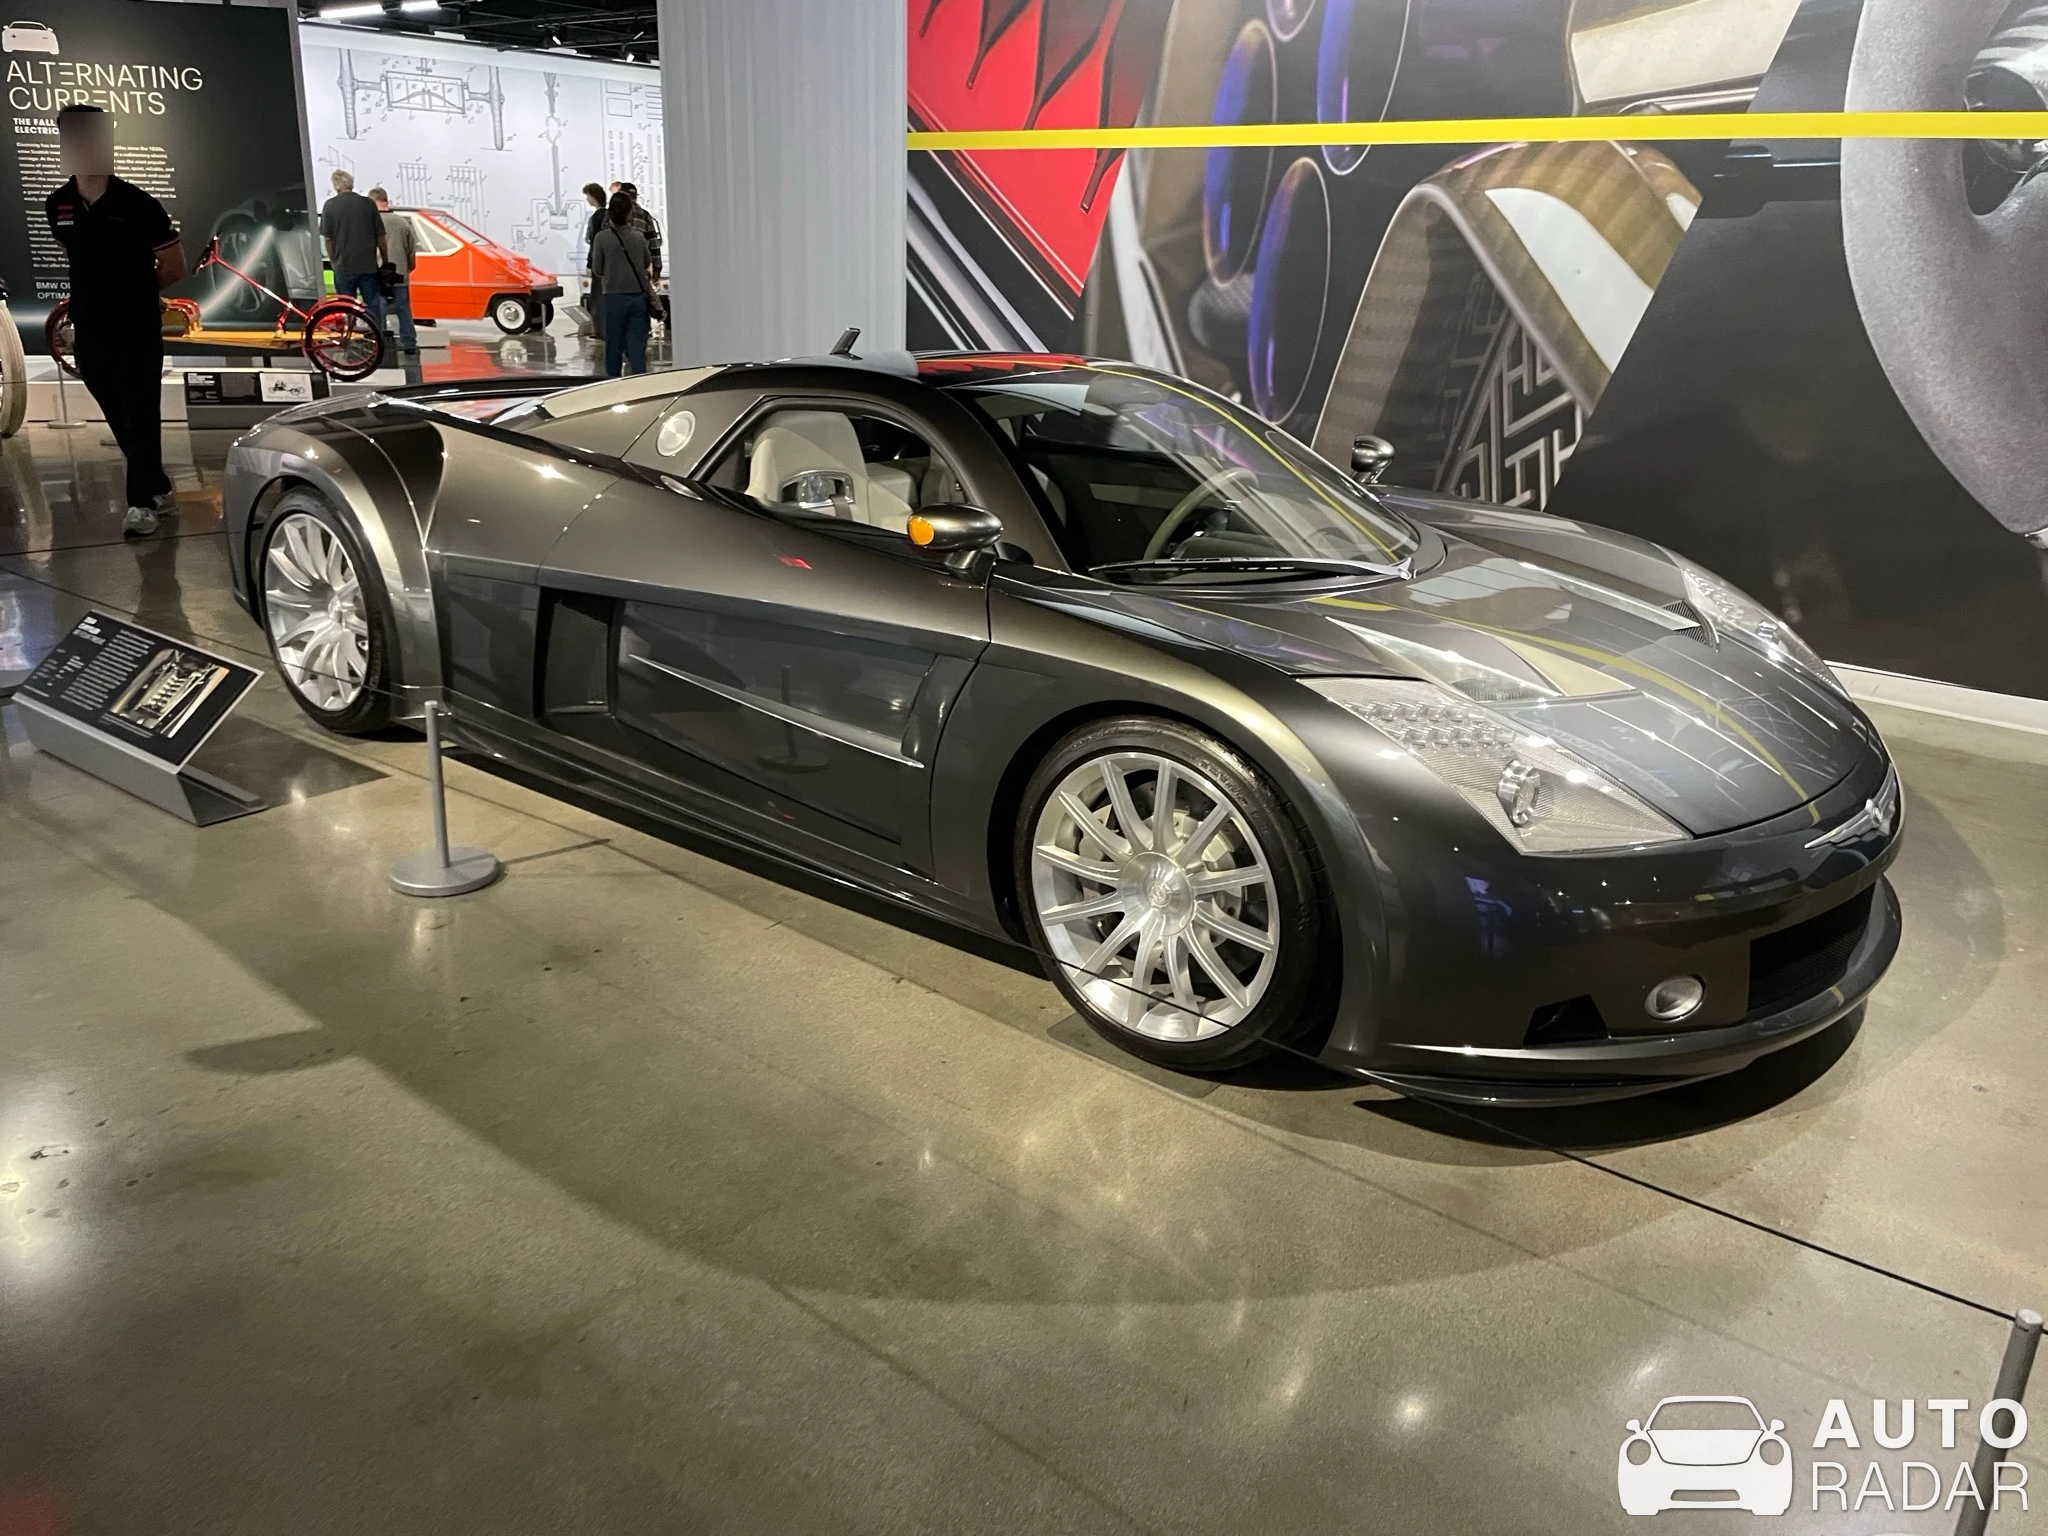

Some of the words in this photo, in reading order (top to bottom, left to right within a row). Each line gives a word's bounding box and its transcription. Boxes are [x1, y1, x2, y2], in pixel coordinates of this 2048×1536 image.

[6, 59, 203, 91] ALTERNATING
[8, 87, 166, 116] CURRENTS
[13, 117, 31, 126] THE
[33, 118, 56, 127] FALL
[36, 281, 59, 290] BMW
